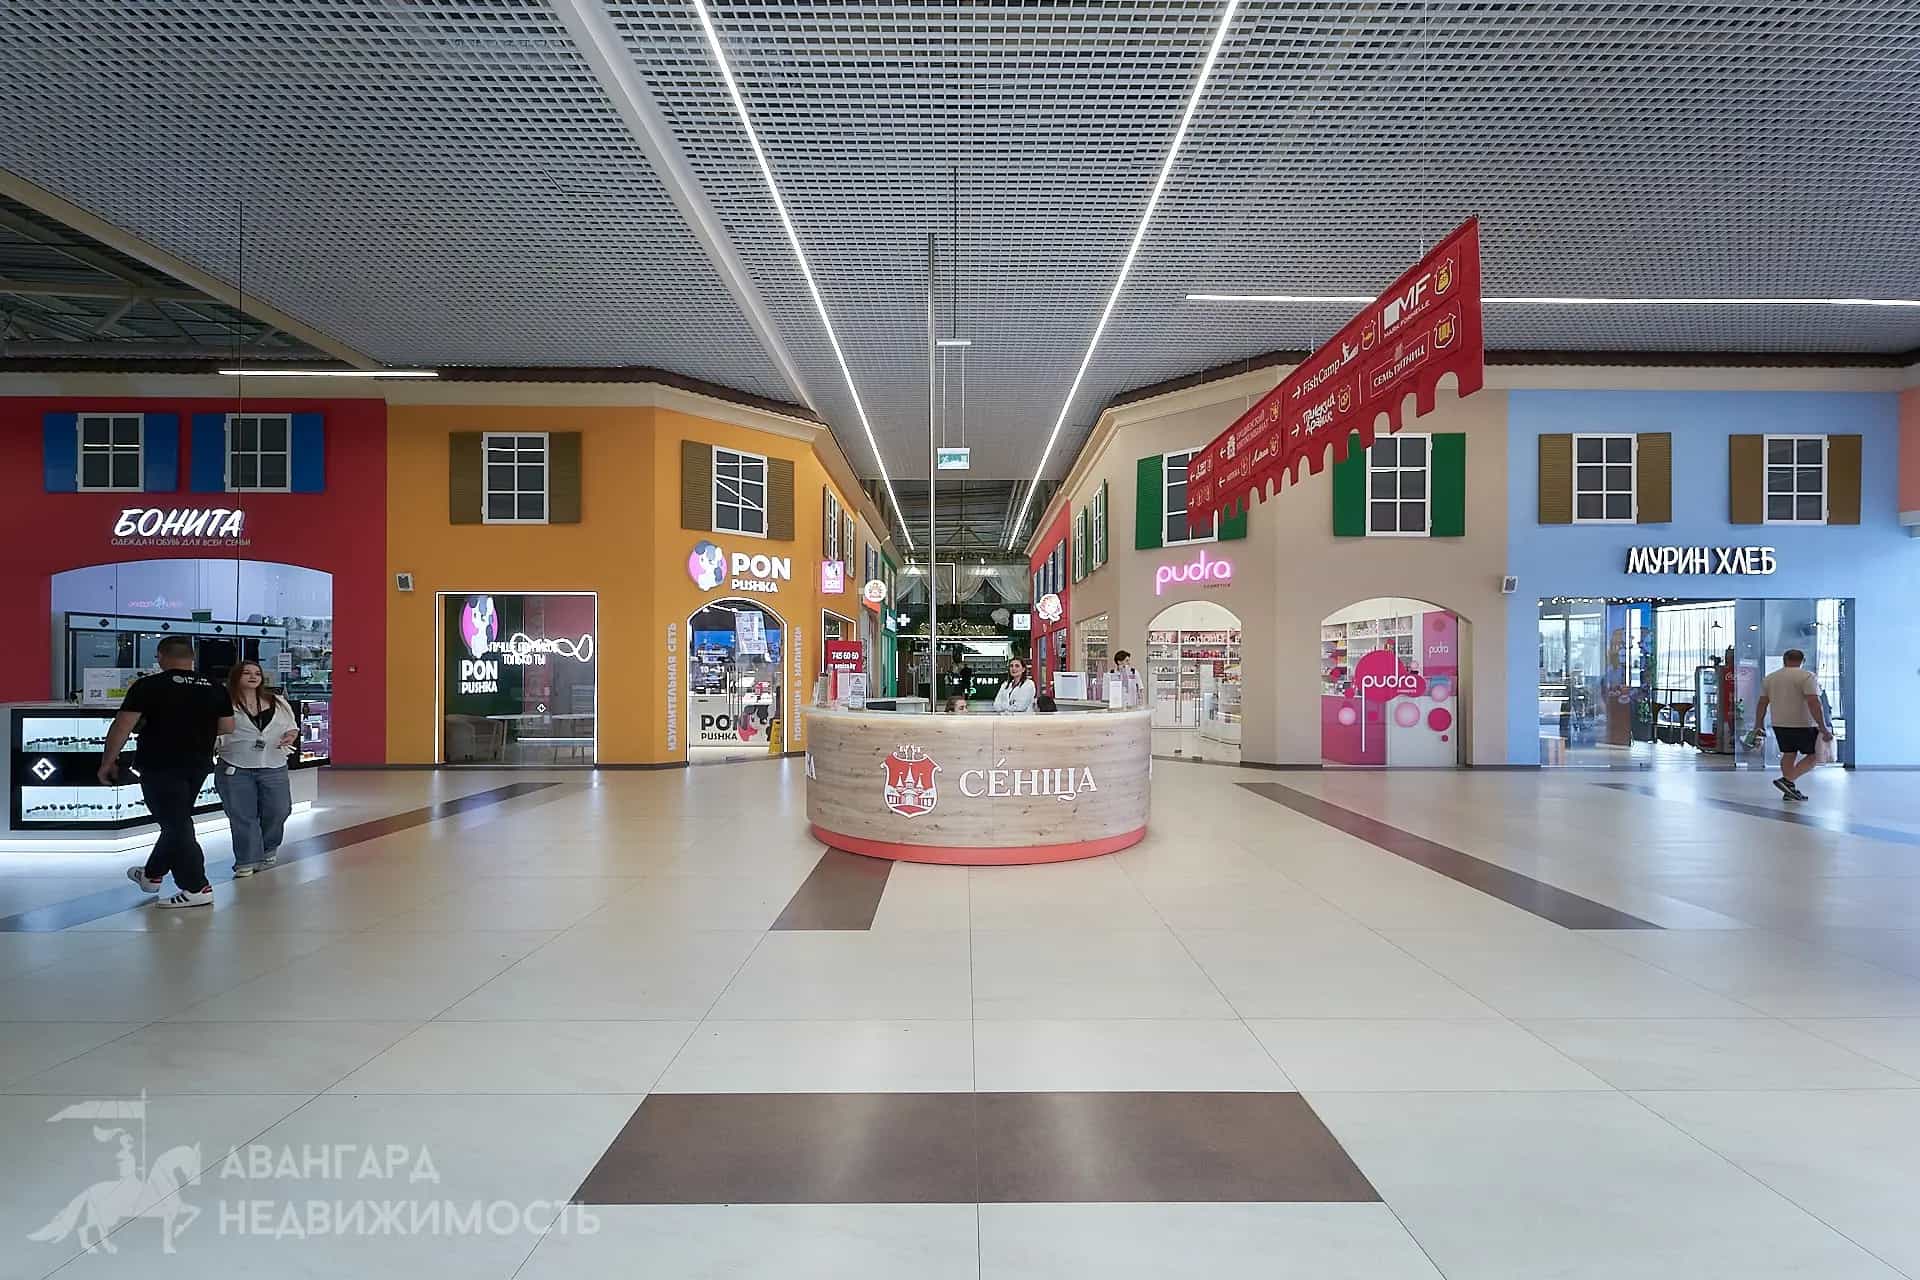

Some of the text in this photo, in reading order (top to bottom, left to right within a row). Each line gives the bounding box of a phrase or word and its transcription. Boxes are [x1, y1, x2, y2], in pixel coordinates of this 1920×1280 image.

[1303, 359, 1340, 396] FishCamp
[1373, 368, 1394, 388] СЕМЬ
[114, 508, 243, 537] БОНИТА
[731, 552, 791, 580] PON
[1156, 549, 1231, 595] pudra
[1627, 546, 1777, 575] МУРИН ХЛЕБ
[731, 579, 778, 593] PUSHKA
[461, 660, 498, 680] PON
[461, 682, 498, 694] PUSHKA
[701, 732, 738, 740] PUSHKA
